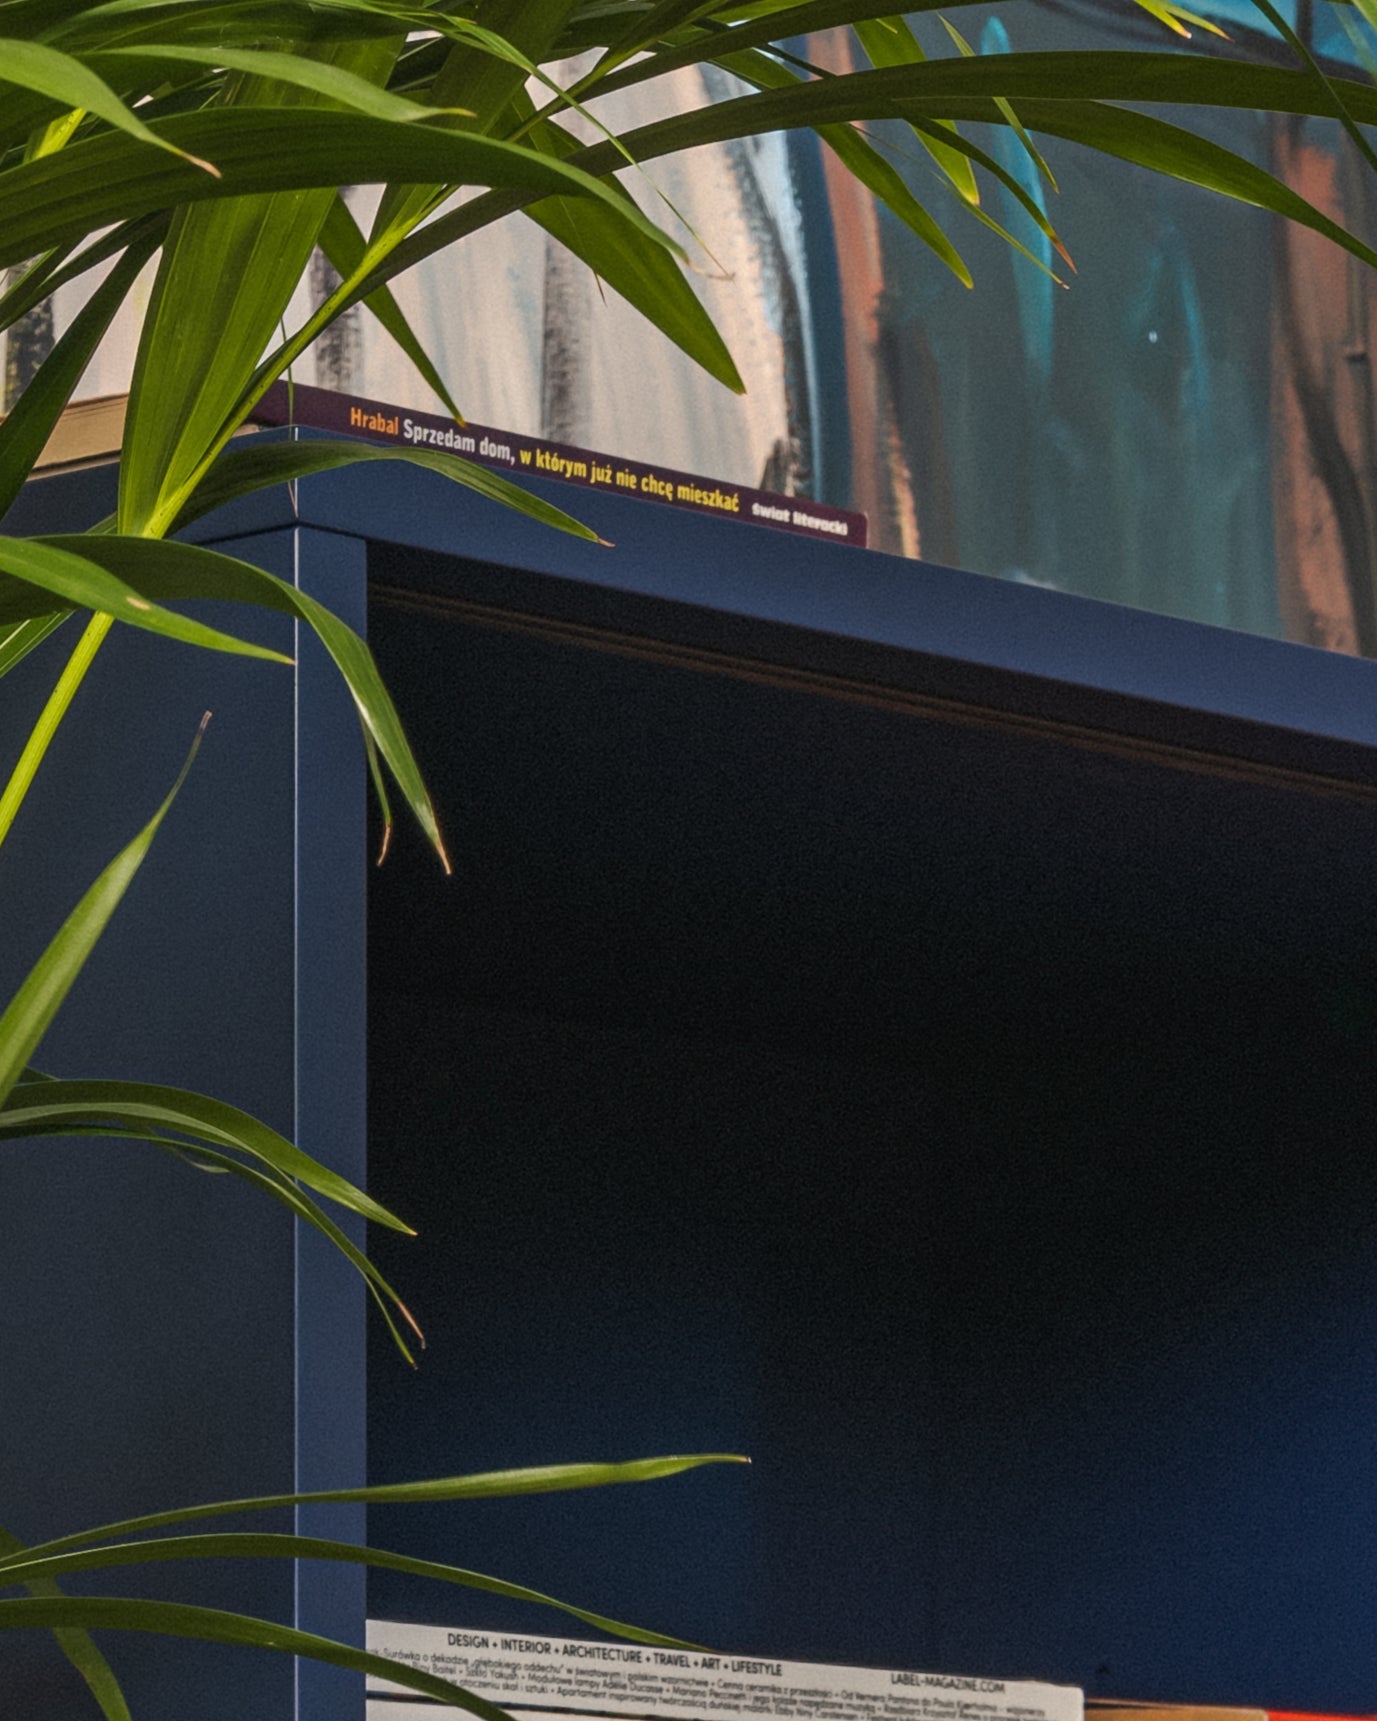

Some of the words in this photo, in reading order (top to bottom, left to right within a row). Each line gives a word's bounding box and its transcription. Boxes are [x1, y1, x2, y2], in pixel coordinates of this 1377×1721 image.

[350, 407, 399, 435] Hrabal
[403, 419, 475, 453] Sprzedam
[480, 436, 515, 466] dom,
[520, 449, 532, 465] w
[536, 449, 586, 478] którym
[590, 461, 612, 484] już
[616, 468, 637, 490] nie
[641, 474, 674, 501] chcę
[677, 483, 740, 512] mieszkać
[792, 511, 849, 536] literacki
[447, 1633, 490, 1649] DESIGN
[500, 1639, 552, 1655] INTERIOR
[562, 1647, 643, 1663] ARCHITECTURE
[653, 1653, 691, 1669] TRAVEL
[701, 1657, 722, 1671] ART
[731, 1660, 783, 1677] LIFESTYLE
